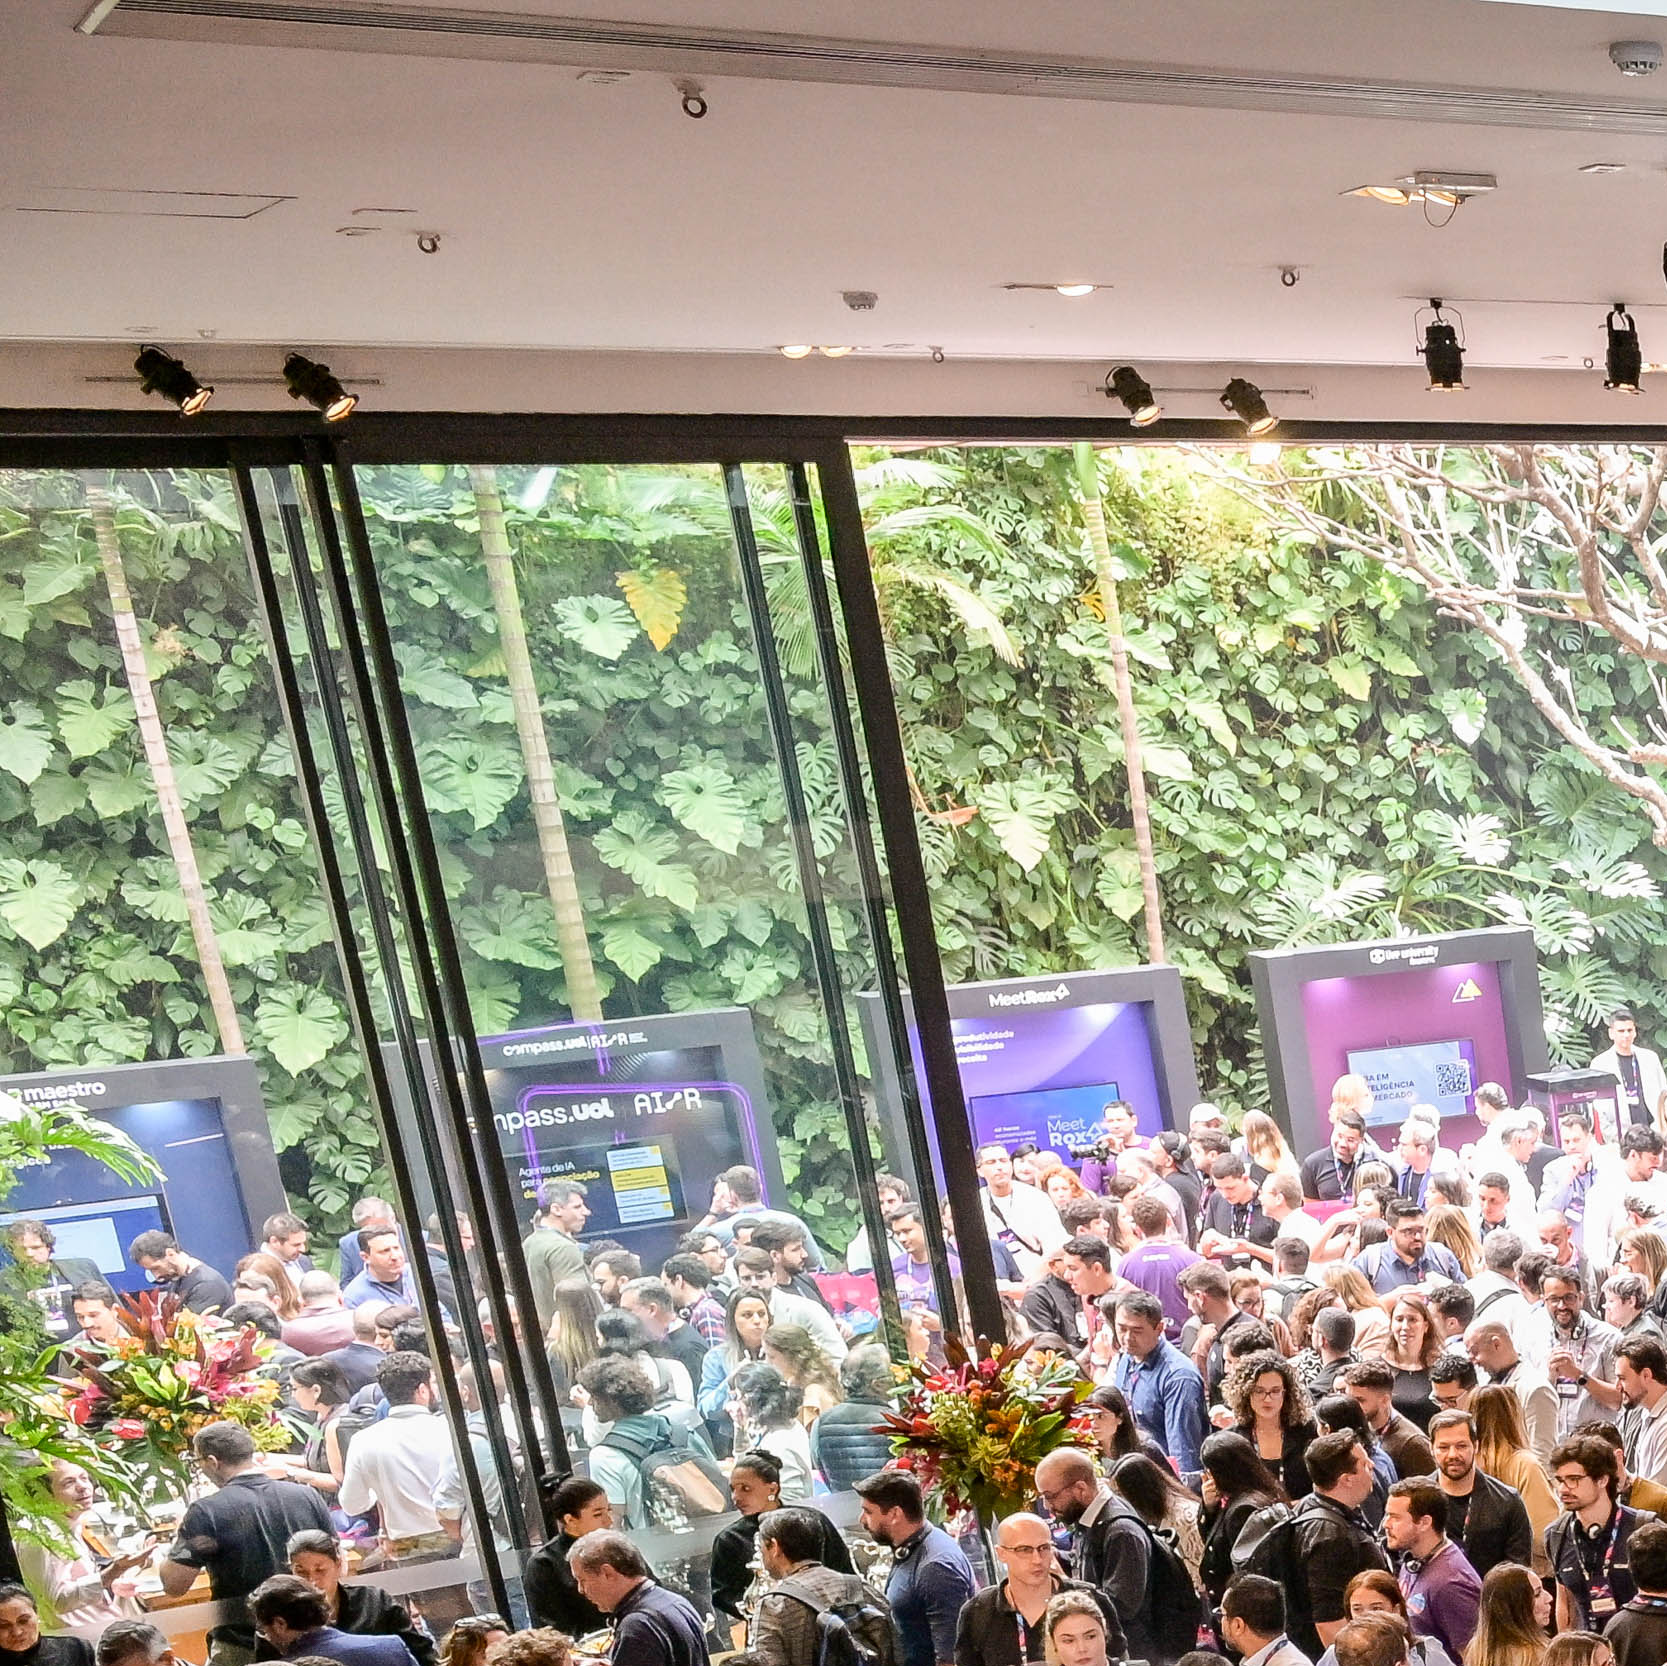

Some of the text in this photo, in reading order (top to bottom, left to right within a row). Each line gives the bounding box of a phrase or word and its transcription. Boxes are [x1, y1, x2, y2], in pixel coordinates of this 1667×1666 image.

[24, 1082, 106, 1102] maestro
[1369, 1079, 1414, 1092] TELIGÊNCIA
[470, 1097, 614, 1134] mpass.uol
[1047, 1117, 1087, 1133] Meet
[1050, 1131, 1086, 1147] Rox
